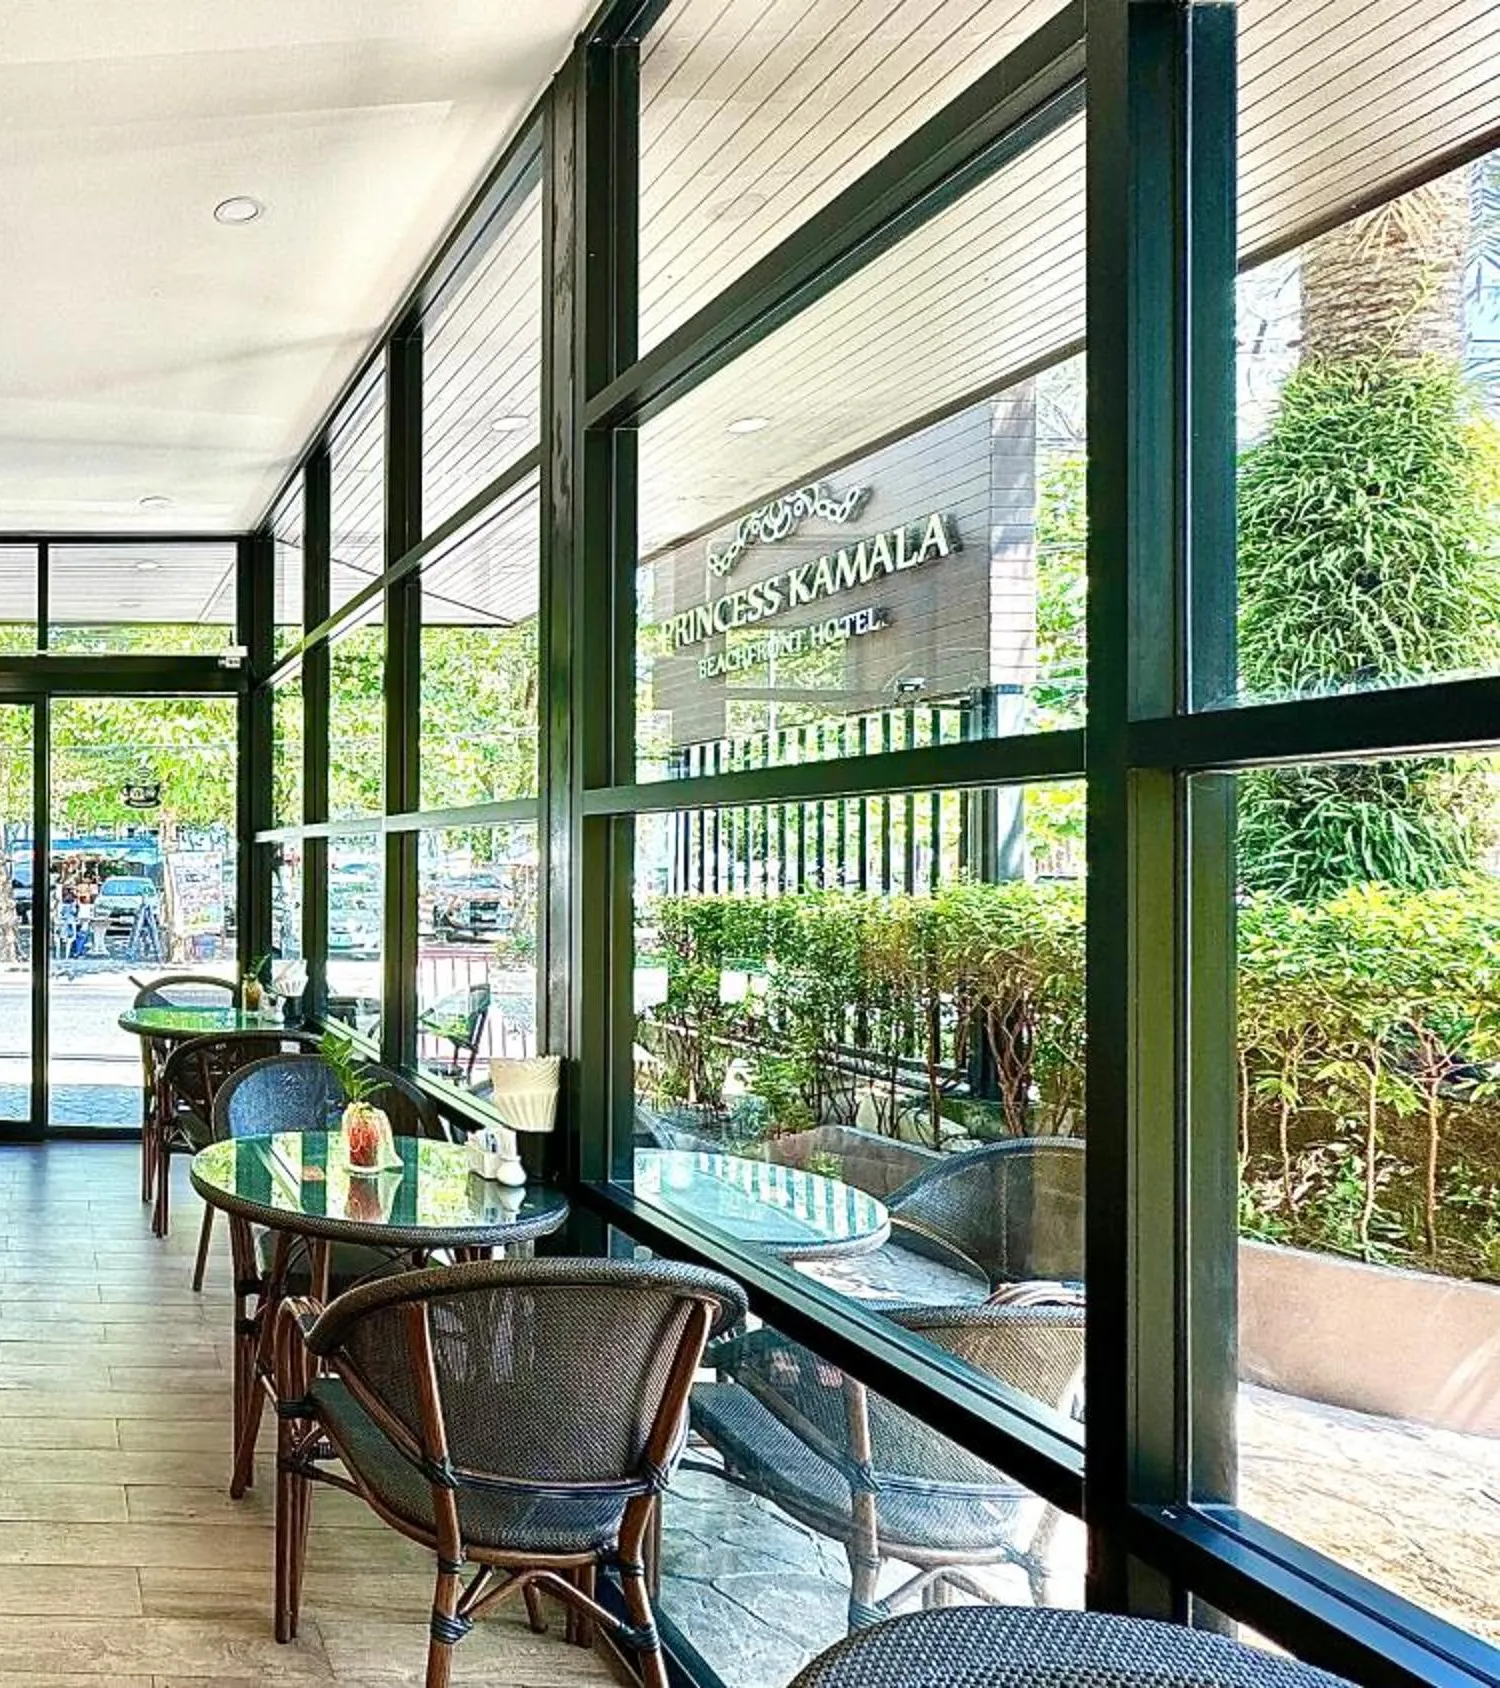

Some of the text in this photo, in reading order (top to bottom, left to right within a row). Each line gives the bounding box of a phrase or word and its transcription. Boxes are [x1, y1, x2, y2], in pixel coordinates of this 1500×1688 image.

[660, 512, 952, 658] PRINCESS KAMALA
[698, 607, 882, 679] BEACHFRONT HOTEL
